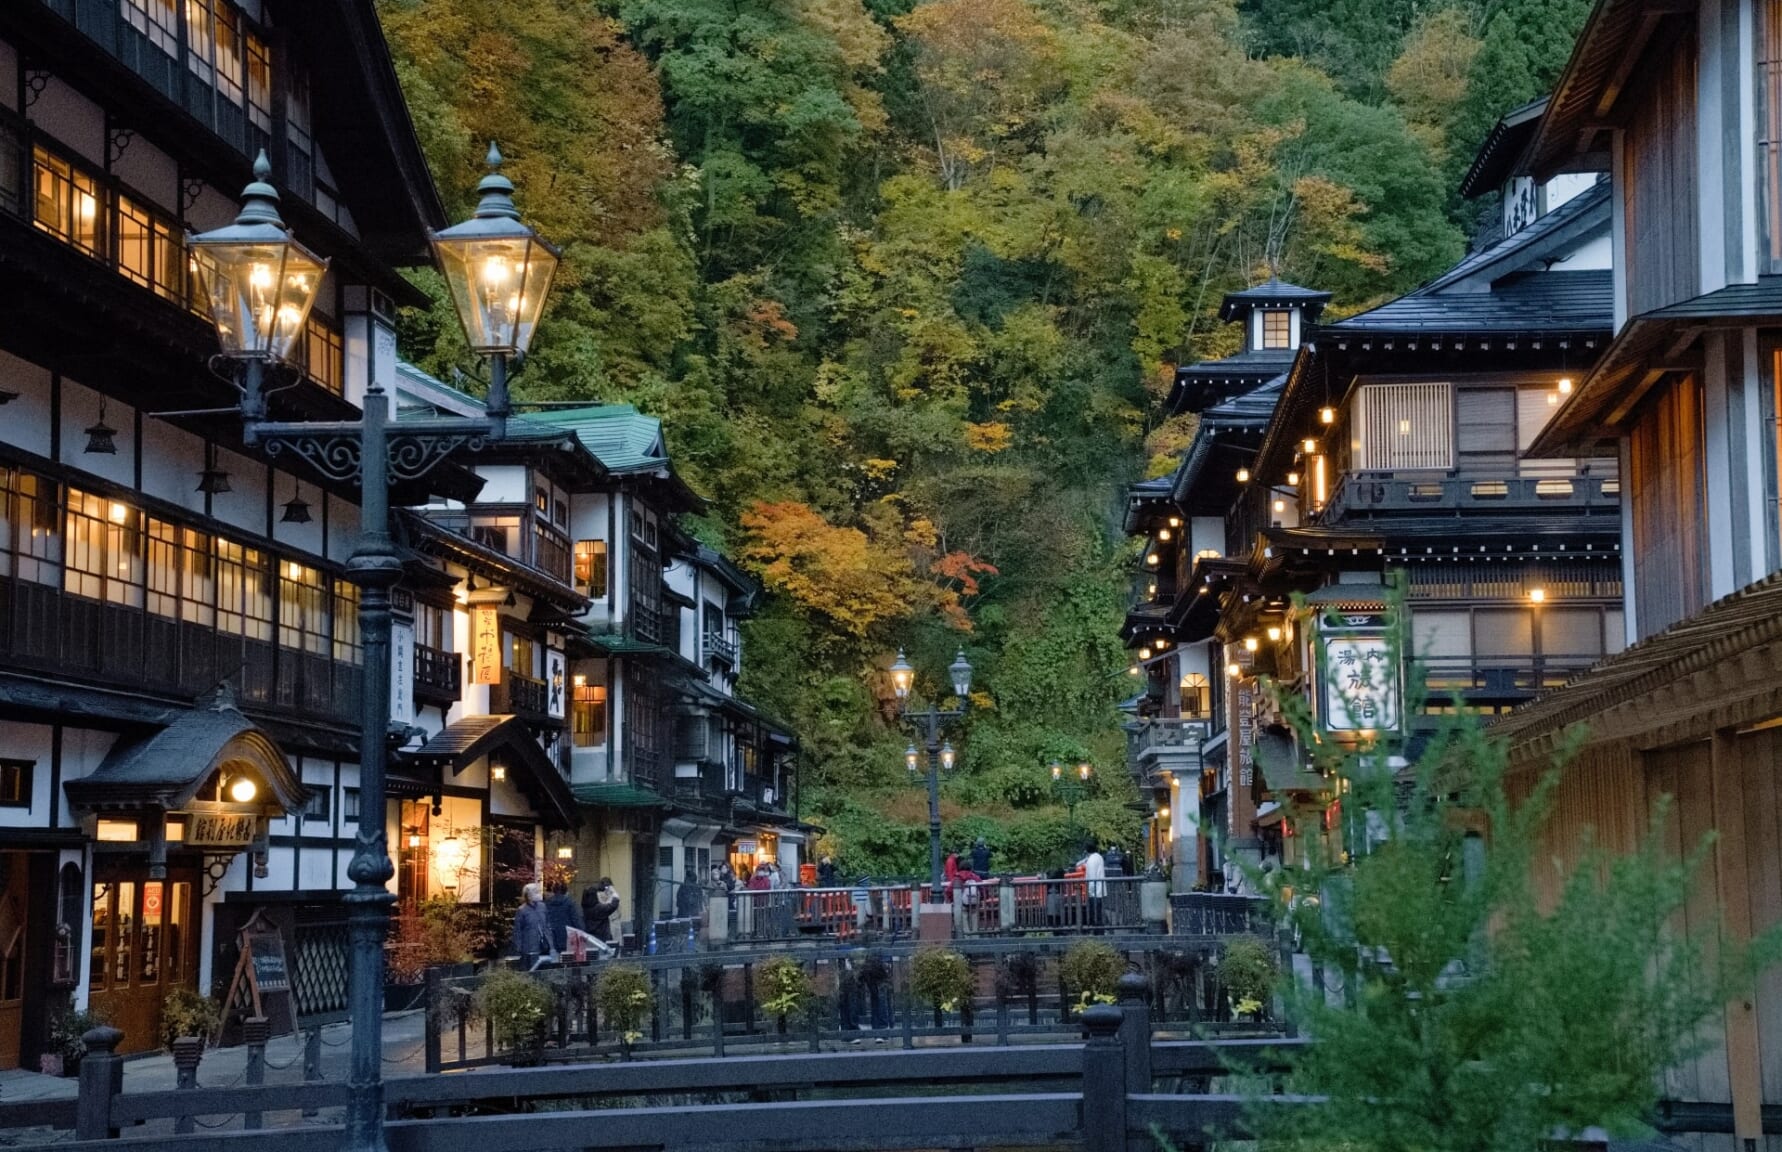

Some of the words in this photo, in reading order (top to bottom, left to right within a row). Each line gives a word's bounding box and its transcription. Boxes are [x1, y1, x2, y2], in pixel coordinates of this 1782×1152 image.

[1238, 689, 1253, 786] 能登屋旅館
